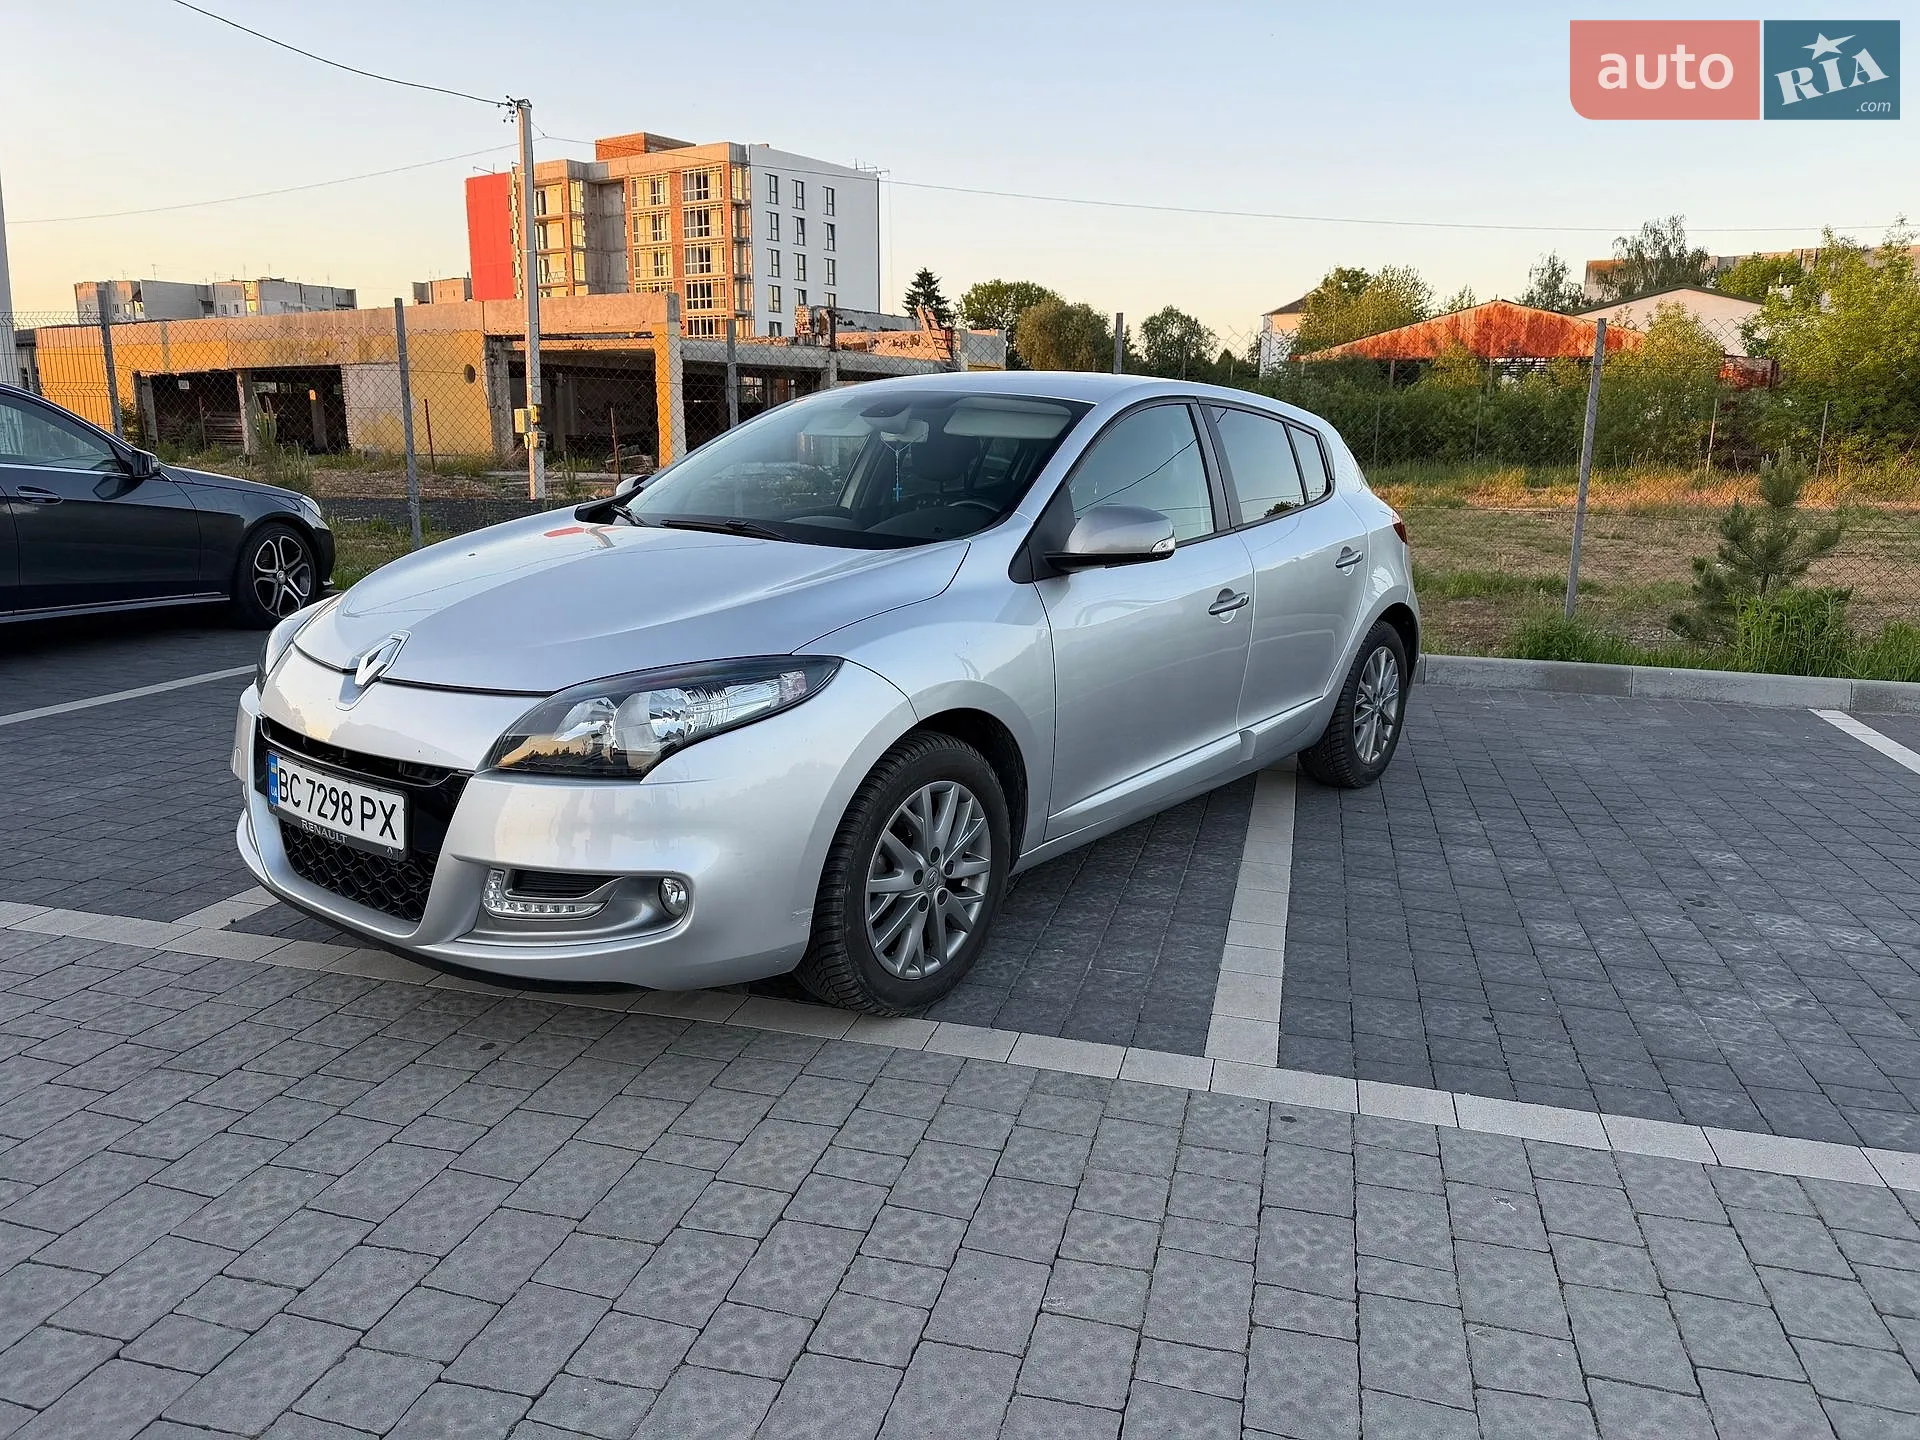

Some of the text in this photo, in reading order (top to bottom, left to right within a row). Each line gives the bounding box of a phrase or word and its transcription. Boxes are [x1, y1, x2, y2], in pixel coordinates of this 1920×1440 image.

[270, 785, 279, 798] UA
[278, 767, 397, 841] BC 7298 PX
[301, 819, 348, 844] RENAULT
